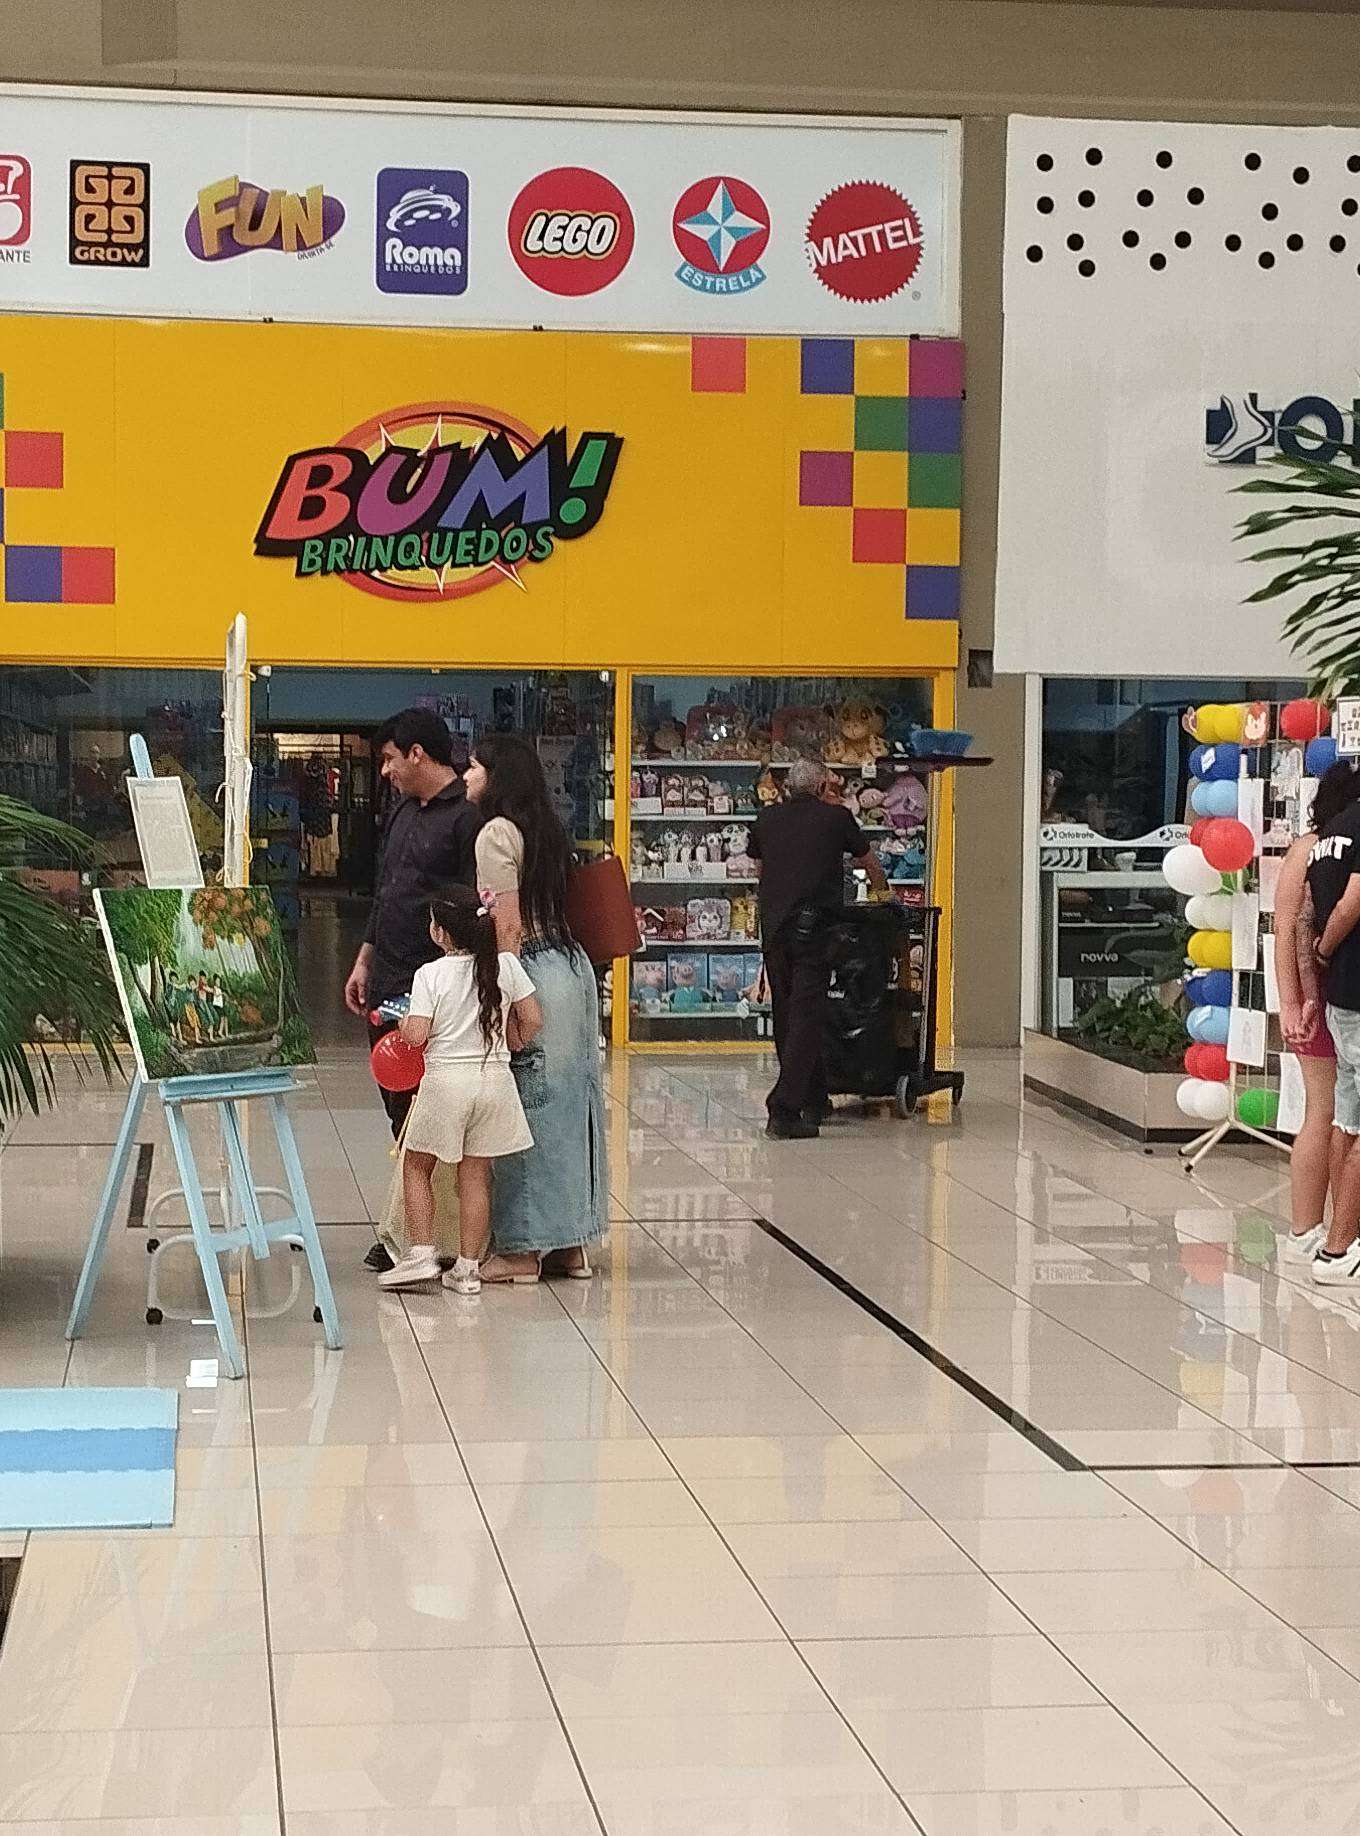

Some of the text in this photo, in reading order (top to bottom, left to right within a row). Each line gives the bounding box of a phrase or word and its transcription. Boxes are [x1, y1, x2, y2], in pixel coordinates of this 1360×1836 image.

[197, 175, 325, 258] FUN
[526, 213, 616, 255] LEGO
[75, 246, 144, 263] GROW
[385, 237, 462, 266] Roma
[810, 217, 925, 269] MATTEL
[385, 264, 462, 275] BRINQUEDOS
[680, 264, 765, 293] ESTRELA
[260, 430, 616, 546] BUM!
[298, 526, 556, 575] BRINQUEDOS
